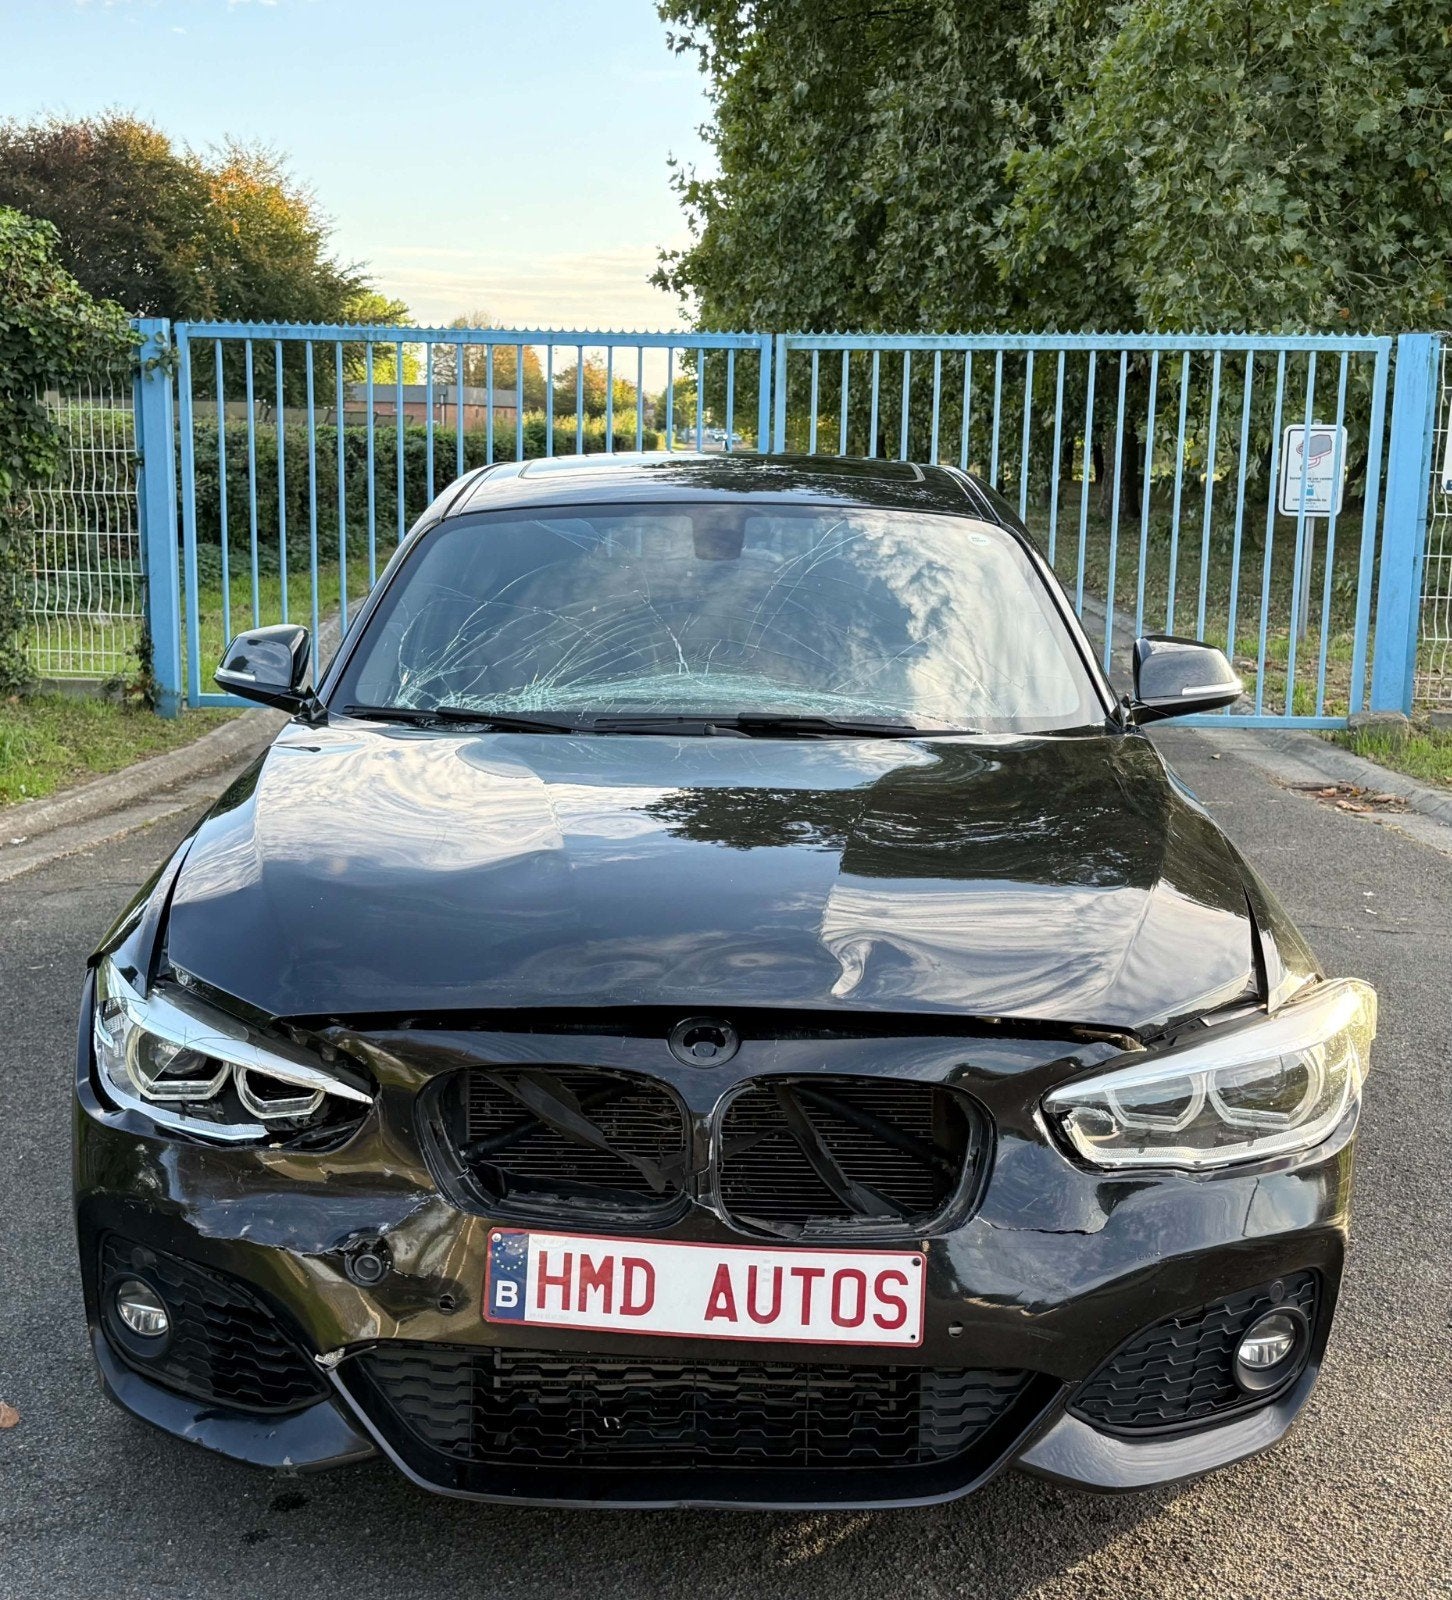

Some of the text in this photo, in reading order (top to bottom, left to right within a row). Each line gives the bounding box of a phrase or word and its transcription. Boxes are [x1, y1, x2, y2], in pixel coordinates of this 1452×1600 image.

[495, 1279, 519, 1308] B
[537, 1251, 909, 1331] HMD AUTOS
